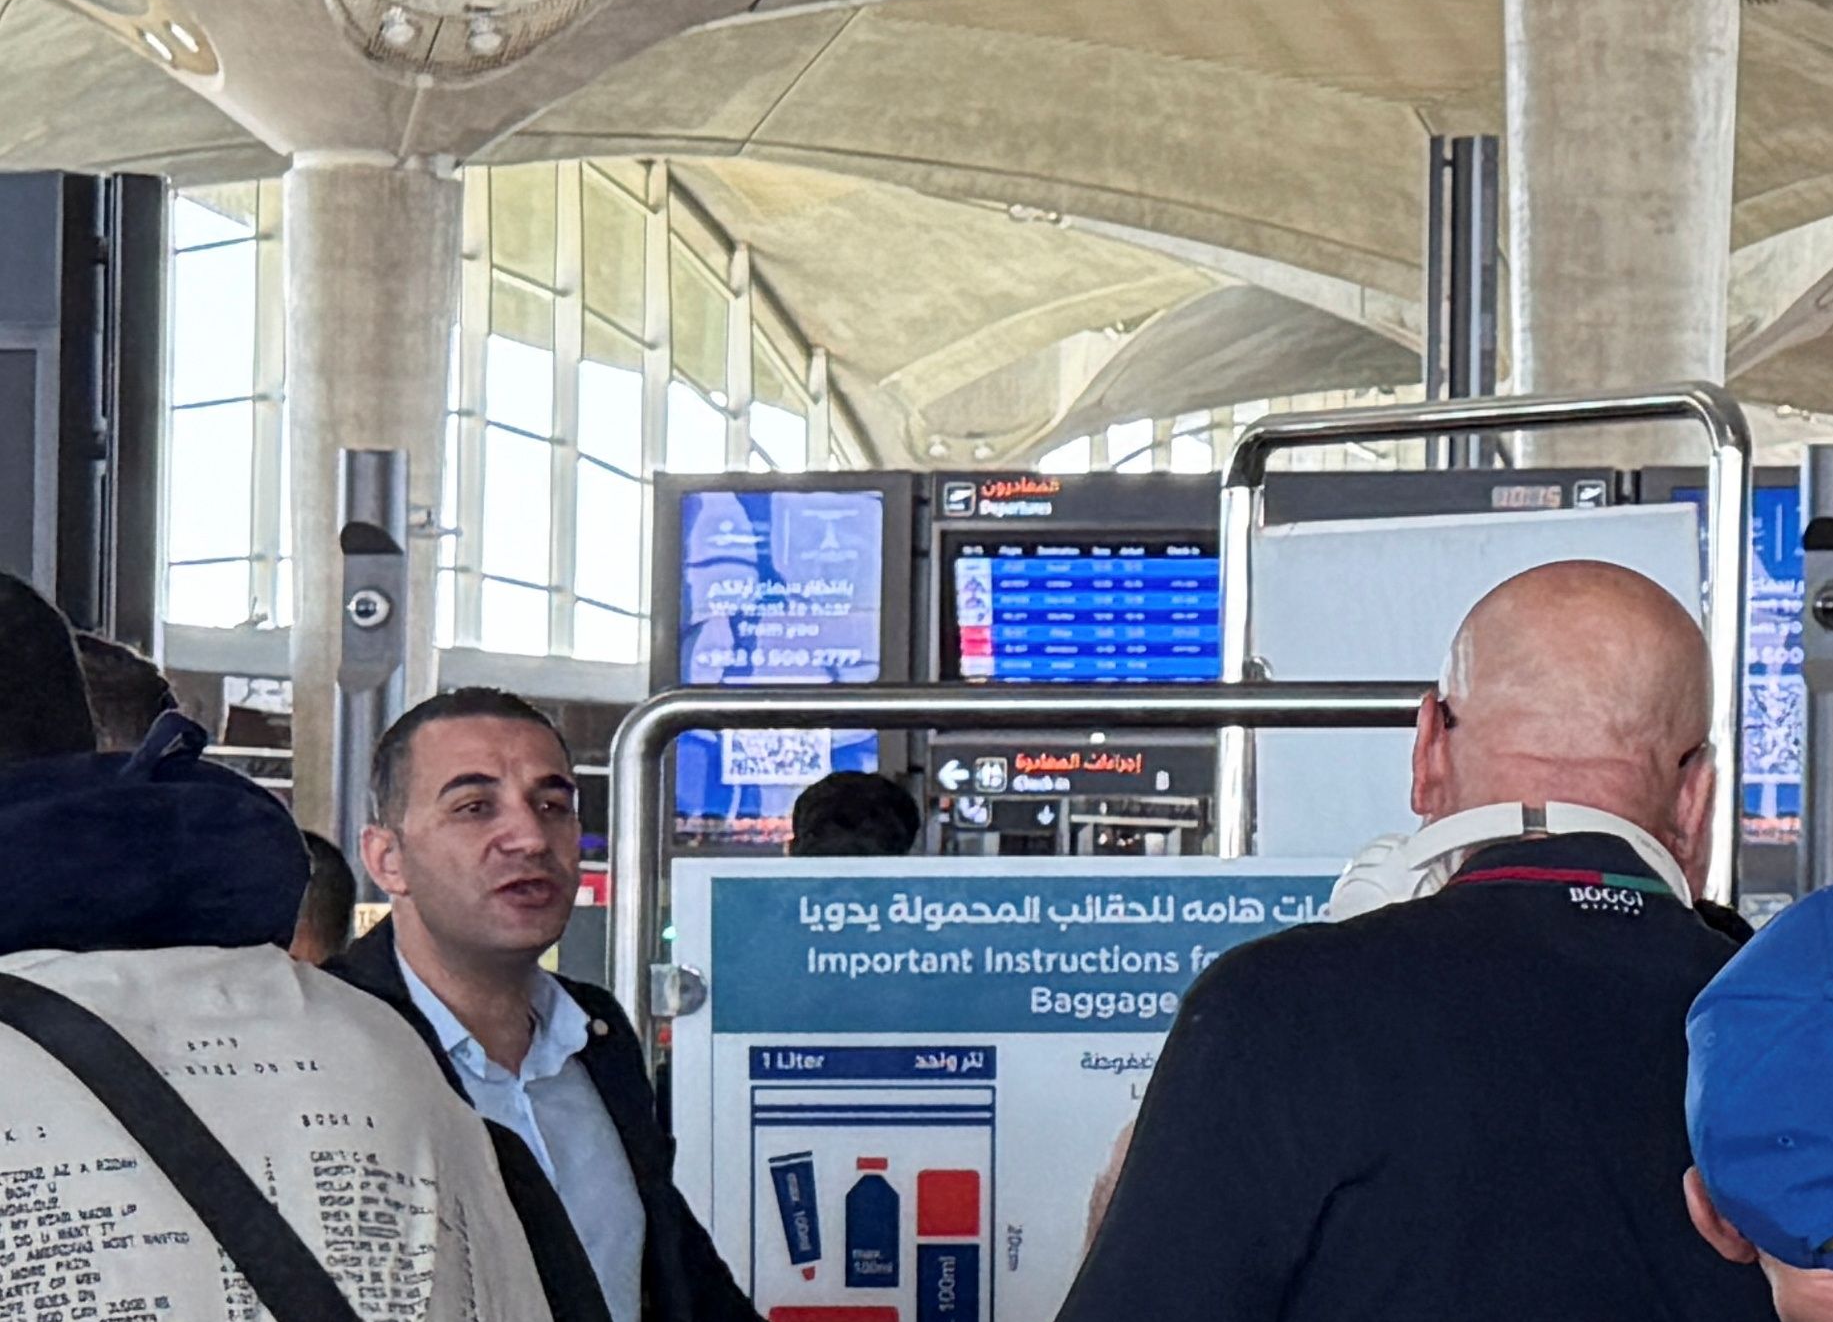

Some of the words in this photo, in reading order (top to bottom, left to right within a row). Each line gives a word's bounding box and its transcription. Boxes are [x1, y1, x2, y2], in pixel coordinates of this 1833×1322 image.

[1182, 897, 1264, 924] هامه
[1569, 885, 1644, 907] BOGGI
[800, 896, 881, 932] يدويا
[887, 896, 1041, 932] المحمولة
[1048, 896, 1175, 932] للحقائب
[807, 947, 973, 979] Important
[984, 946, 1179, 974] Instructions
[1030, 987, 1178, 1018] Baggage
[762, 1055, 769, 1069] 1
[776, 1053, 825, 1071] Liter
[938, 1255, 956, 1313] 100ml
